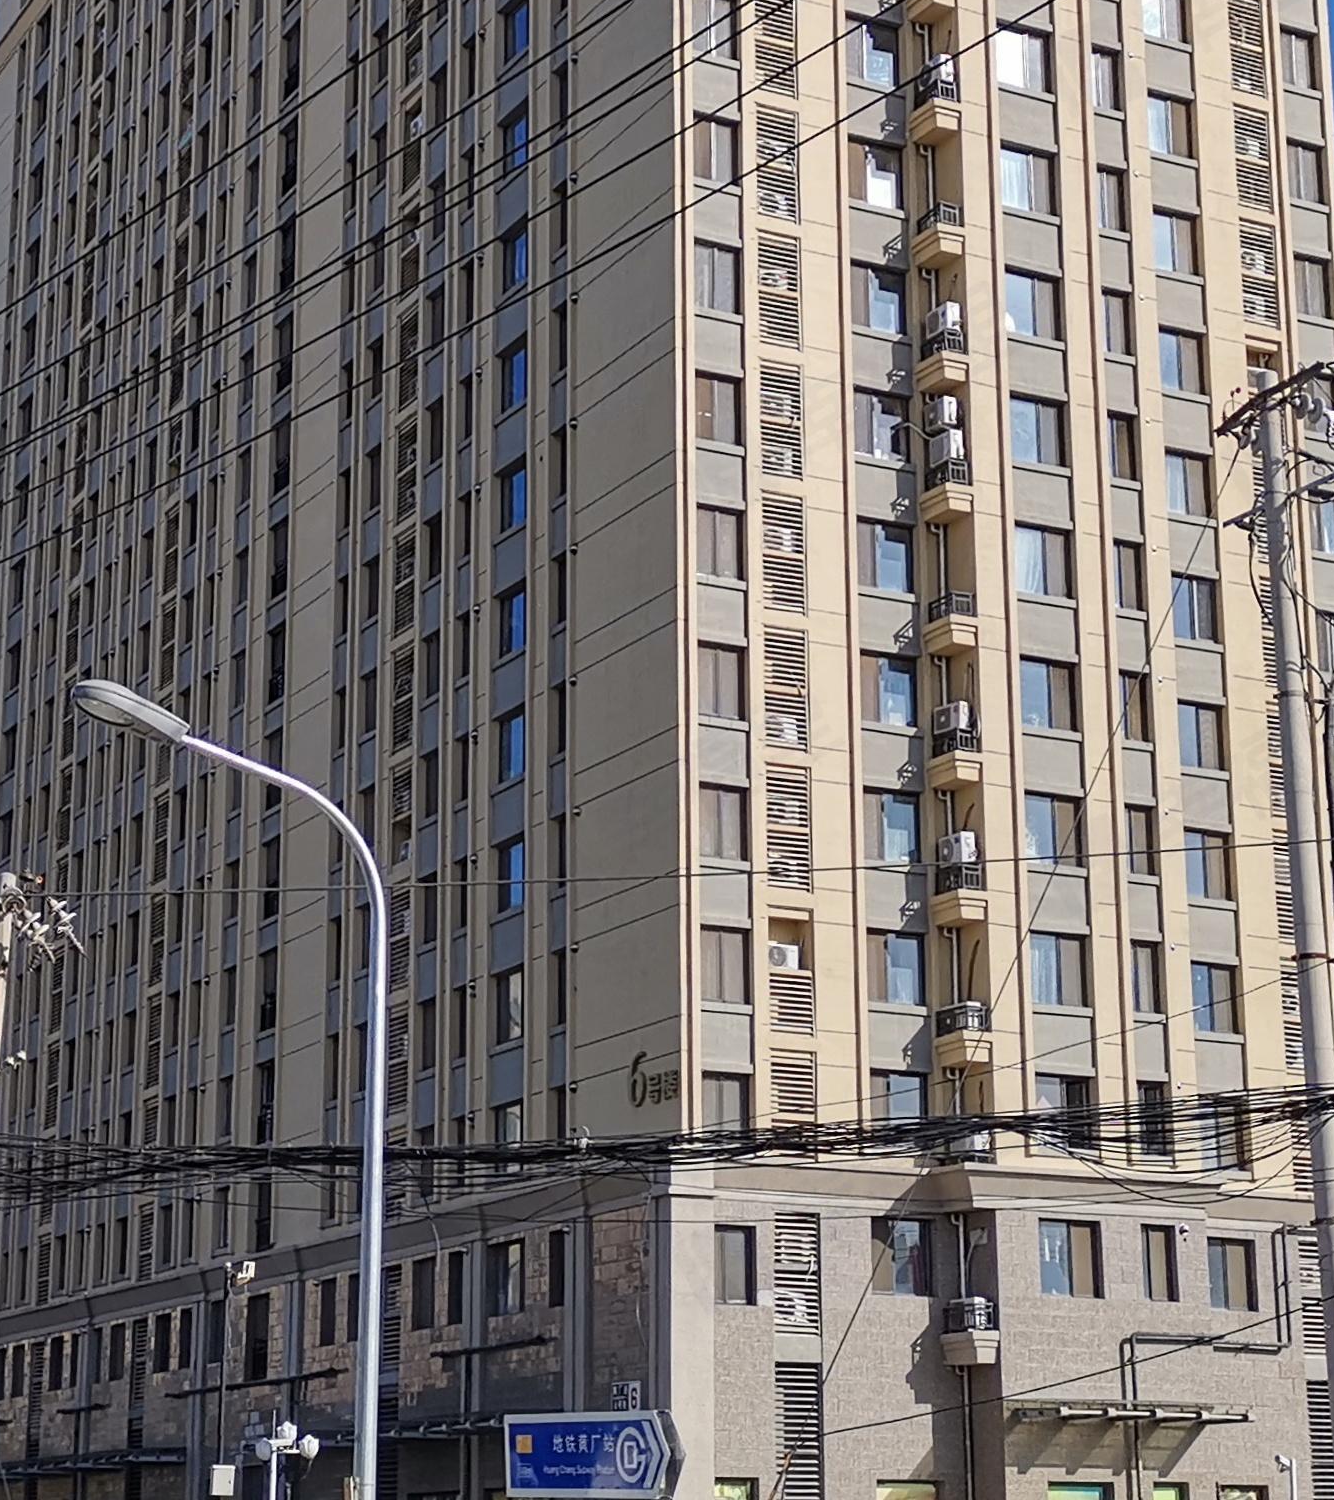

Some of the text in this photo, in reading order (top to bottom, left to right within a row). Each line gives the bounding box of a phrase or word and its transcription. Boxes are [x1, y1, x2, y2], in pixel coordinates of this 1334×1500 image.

[552, 1433, 615, 1454] 地铁黄厂站
